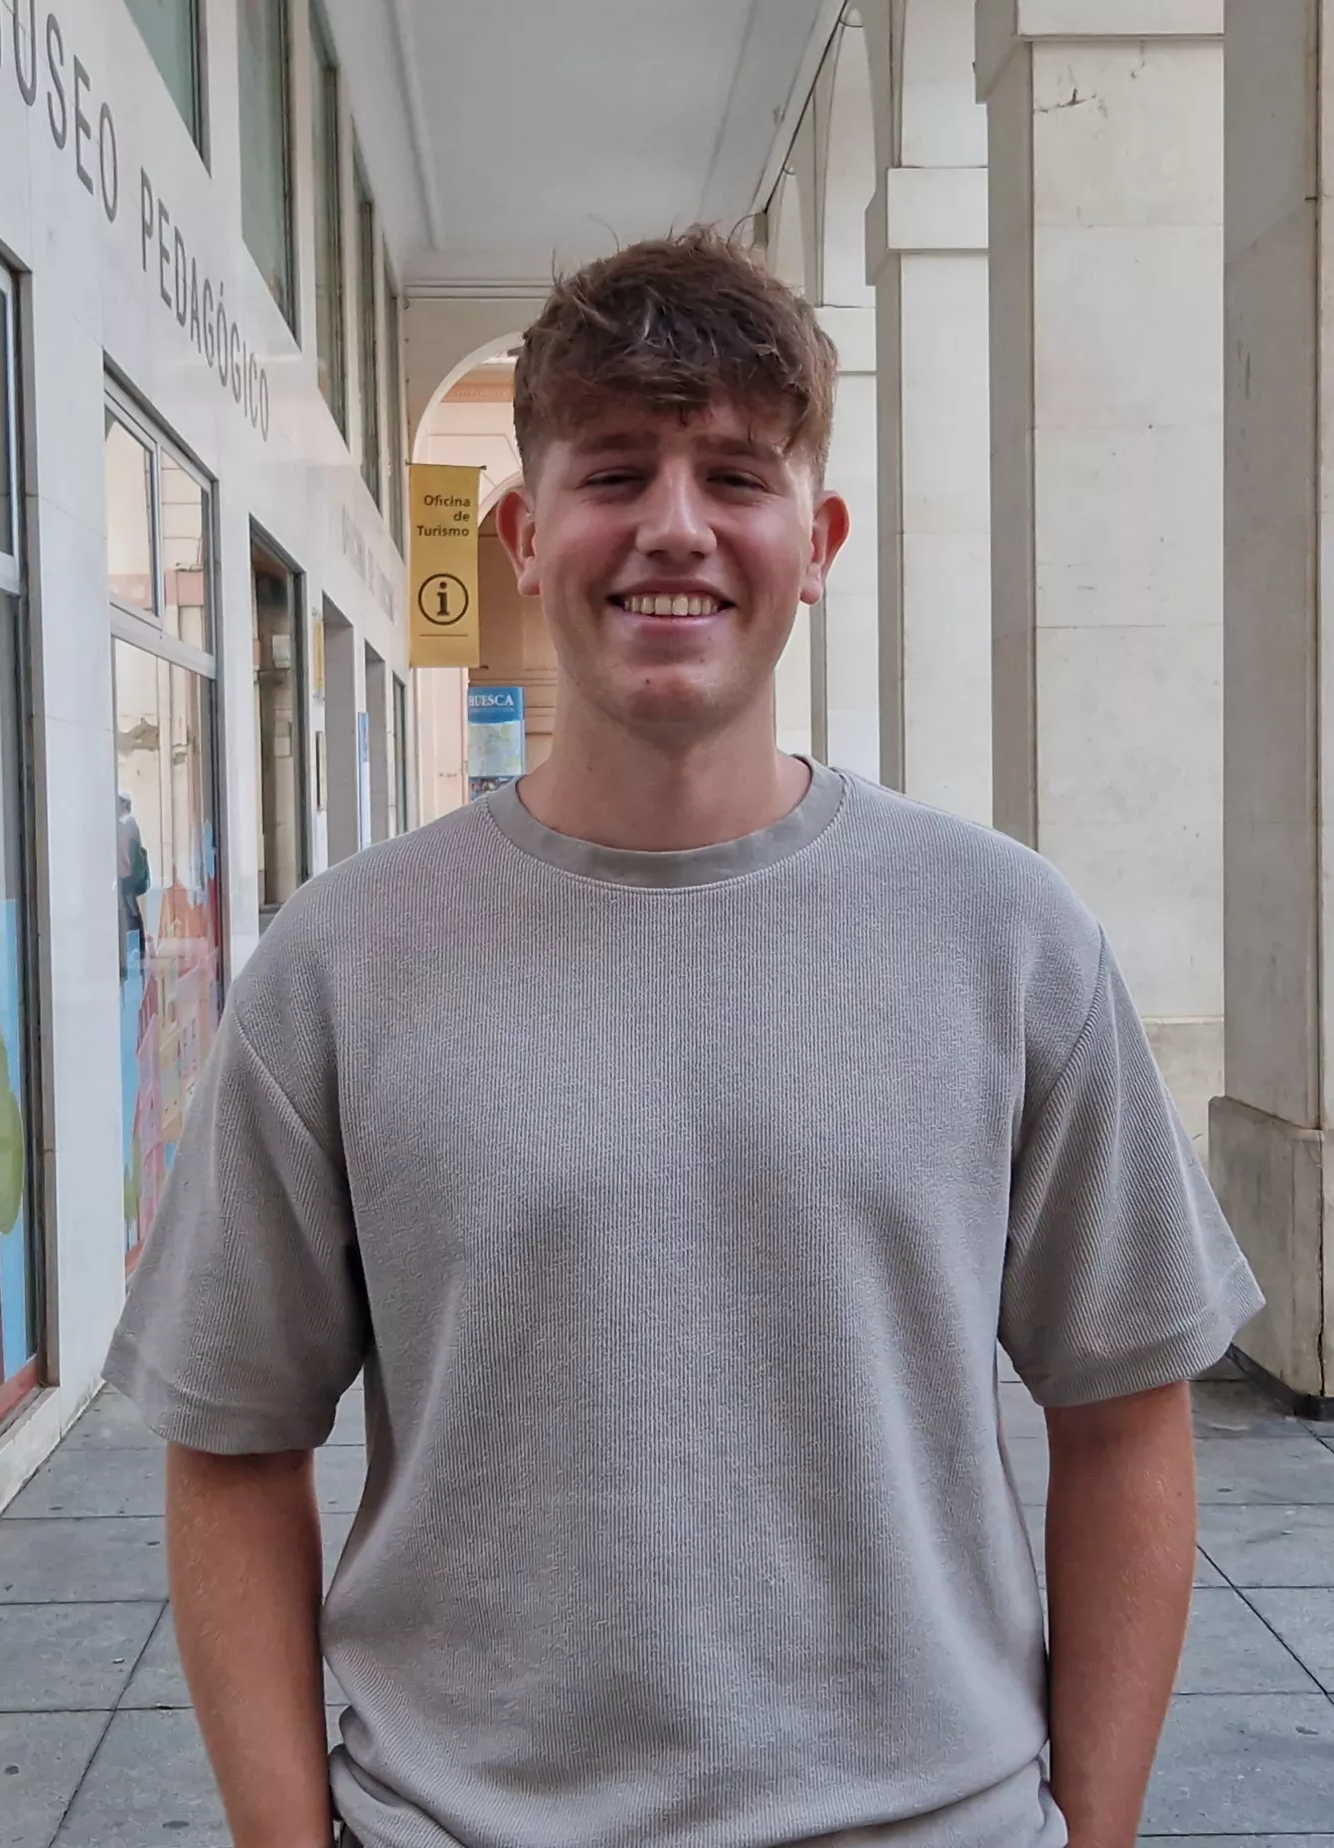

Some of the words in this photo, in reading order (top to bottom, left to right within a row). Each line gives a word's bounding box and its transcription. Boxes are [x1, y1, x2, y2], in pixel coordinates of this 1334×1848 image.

[140, 165, 270, 443] PEDAGÓGICO
[423, 494, 471, 508] Oficina
[453, 510, 470, 522] de
[416, 525, 470, 537] Turismo
